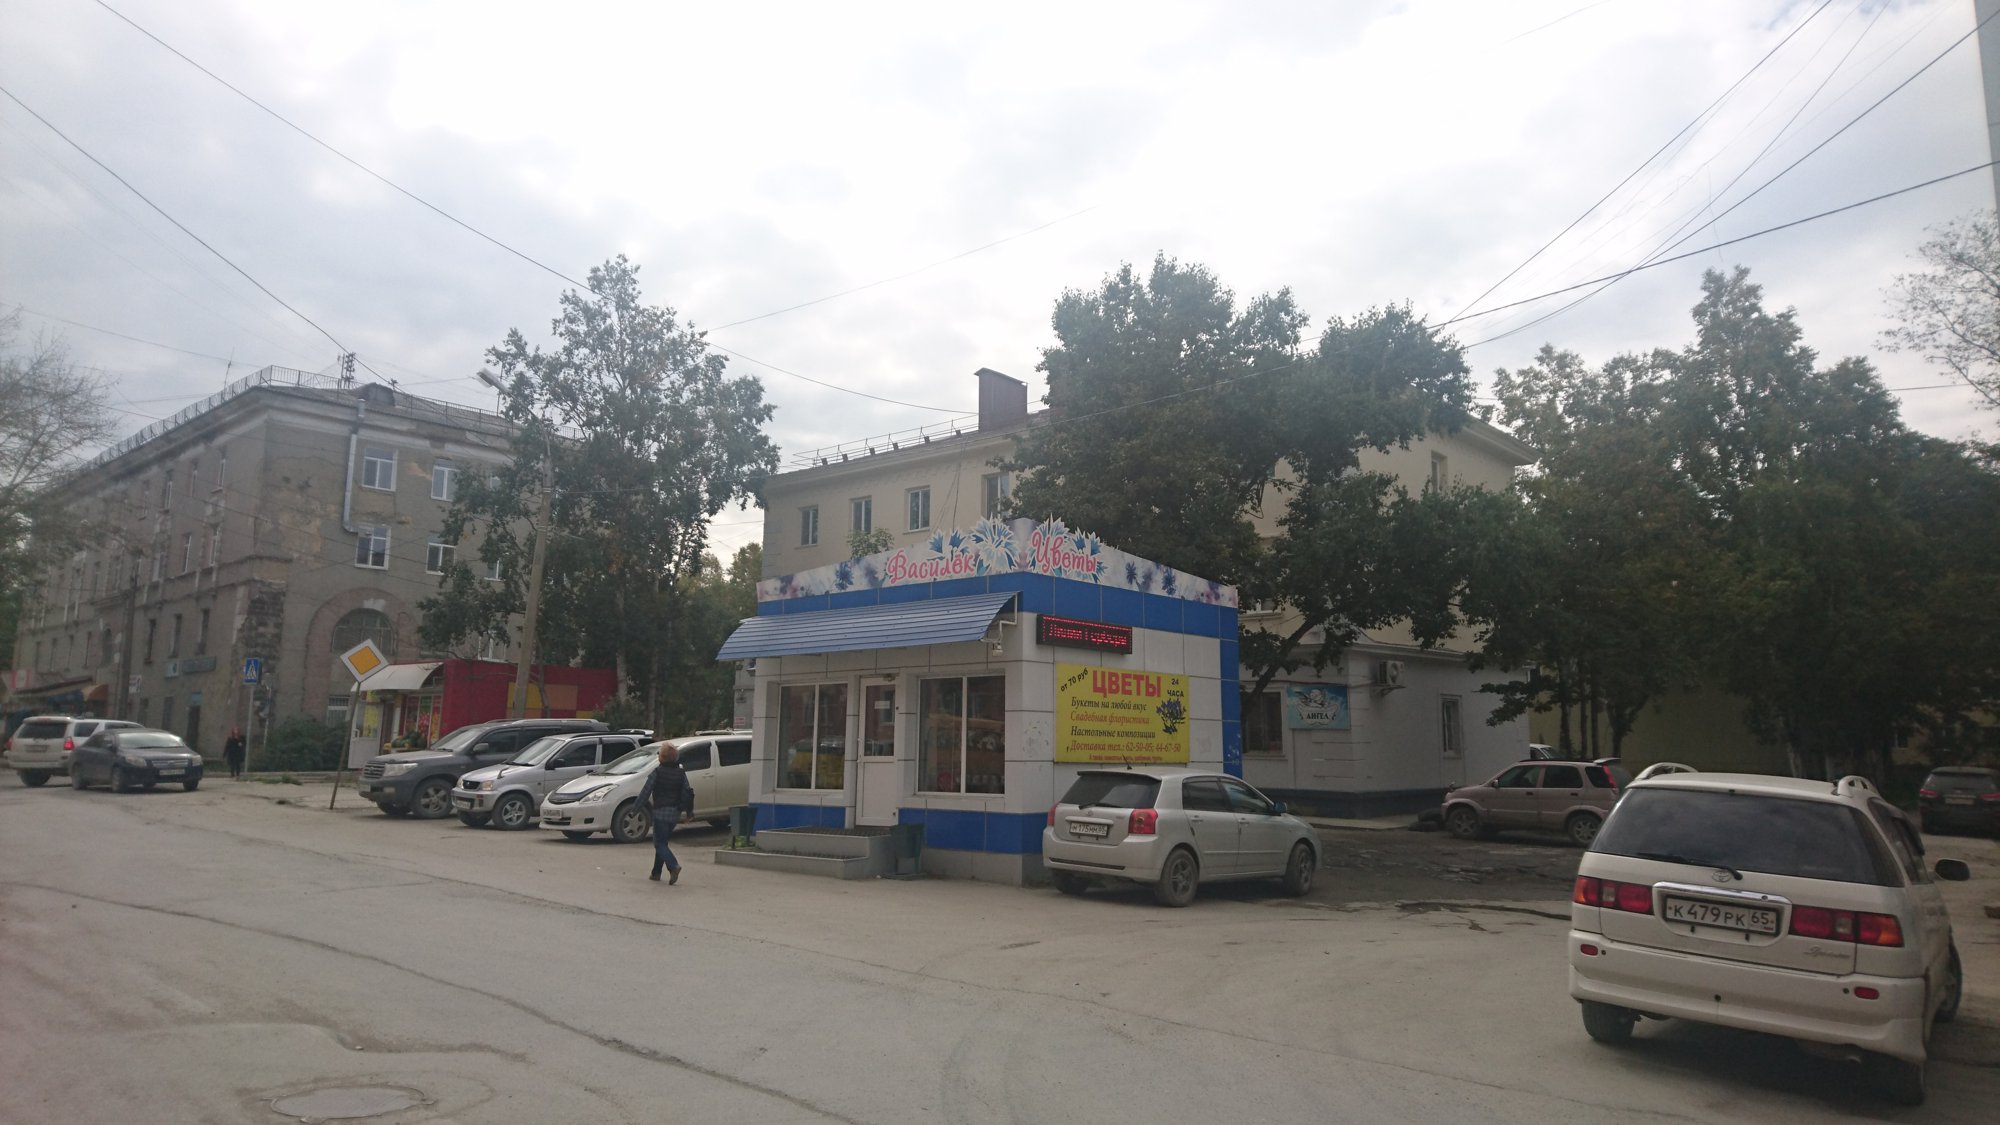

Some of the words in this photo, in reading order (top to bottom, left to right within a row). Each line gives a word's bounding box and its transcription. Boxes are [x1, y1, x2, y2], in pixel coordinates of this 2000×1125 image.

[1031, 530, 1096, 573] Цветы
[888, 549, 975, 582] Василёк
[1060, 683, 1067, 692] от
[1068, 676, 1077, 686] 70
[1077, 667, 1088, 682] руб
[1092, 670, 1161, 698] ЦВЕТЫ
[1167, 689, 1184, 698] ЧАСА
[1071, 697, 1100, 710] Букеты
[1111, 700, 1132, 710] любой
[1133, 703, 1147, 713] вкус
[1070, 711, 1107, 722] Свадебная
[1109, 714, 1150, 726] флористика
[1071, 726, 1116, 738] Настольные
[1117, 729, 1156, 740] композиции
[1070, 740, 1106, 752] Доставка
